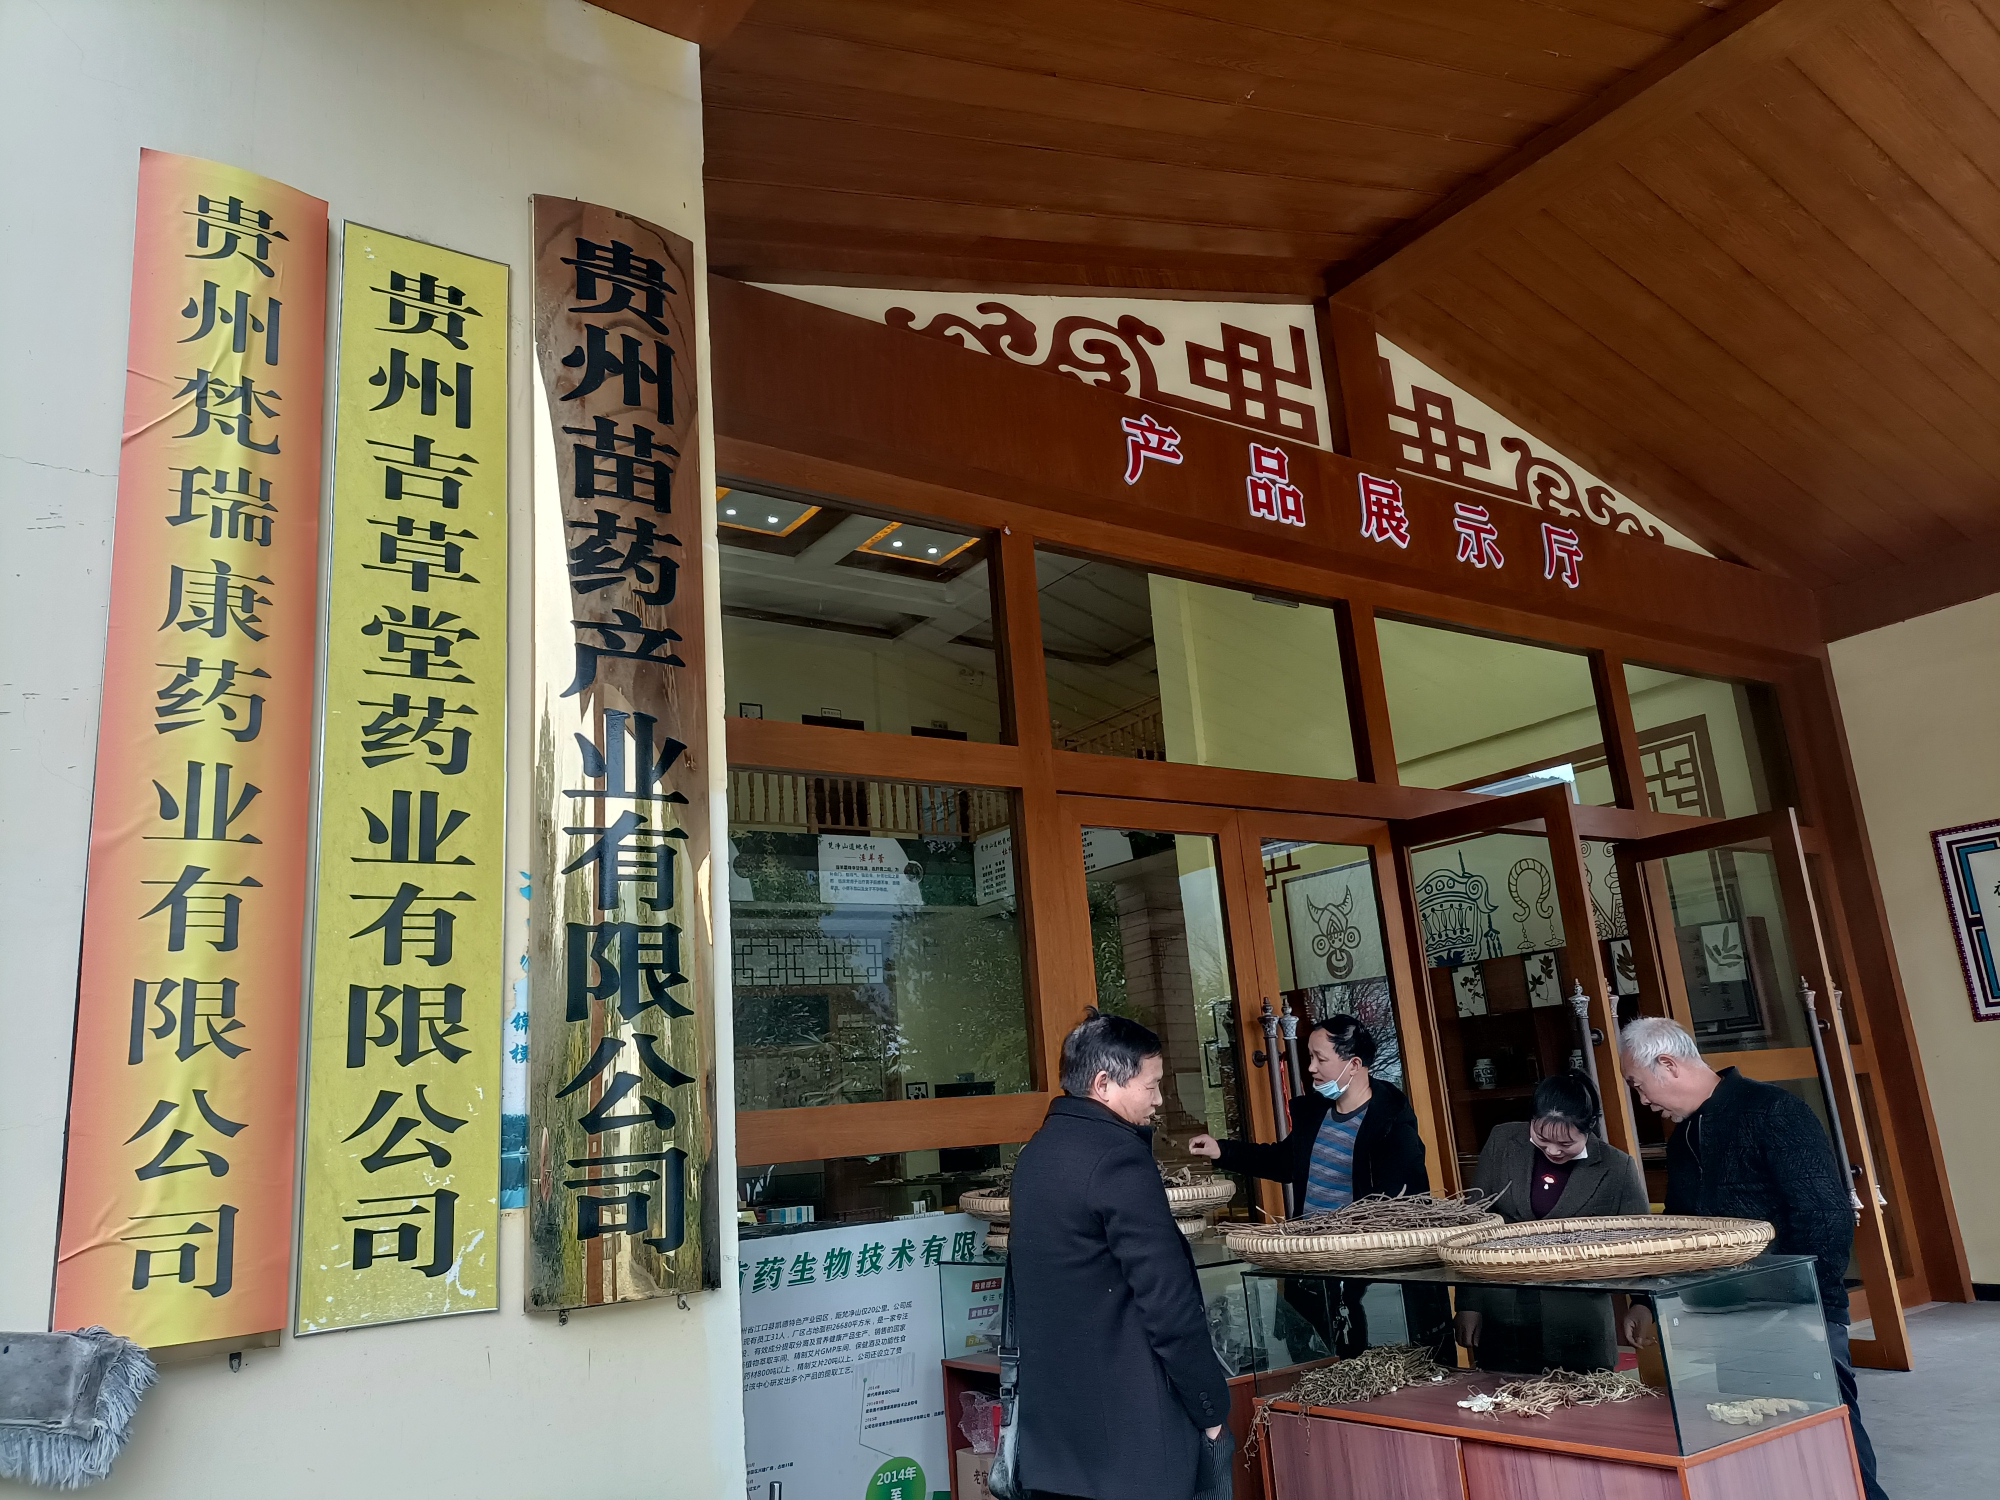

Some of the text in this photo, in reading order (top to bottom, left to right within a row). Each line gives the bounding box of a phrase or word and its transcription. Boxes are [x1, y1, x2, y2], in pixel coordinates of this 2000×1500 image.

[120, 193, 291, 1298] 贵州梵瑞康药业有限公司
[341, 270, 483, 1278] 贵州吉草堂药业有限公司
[556, 236, 696, 1254] 贵州苗药产业有限公司
[1120, 413, 1585, 590] 产品展示厅
[876, 1466, 917, 1486] 2014年
